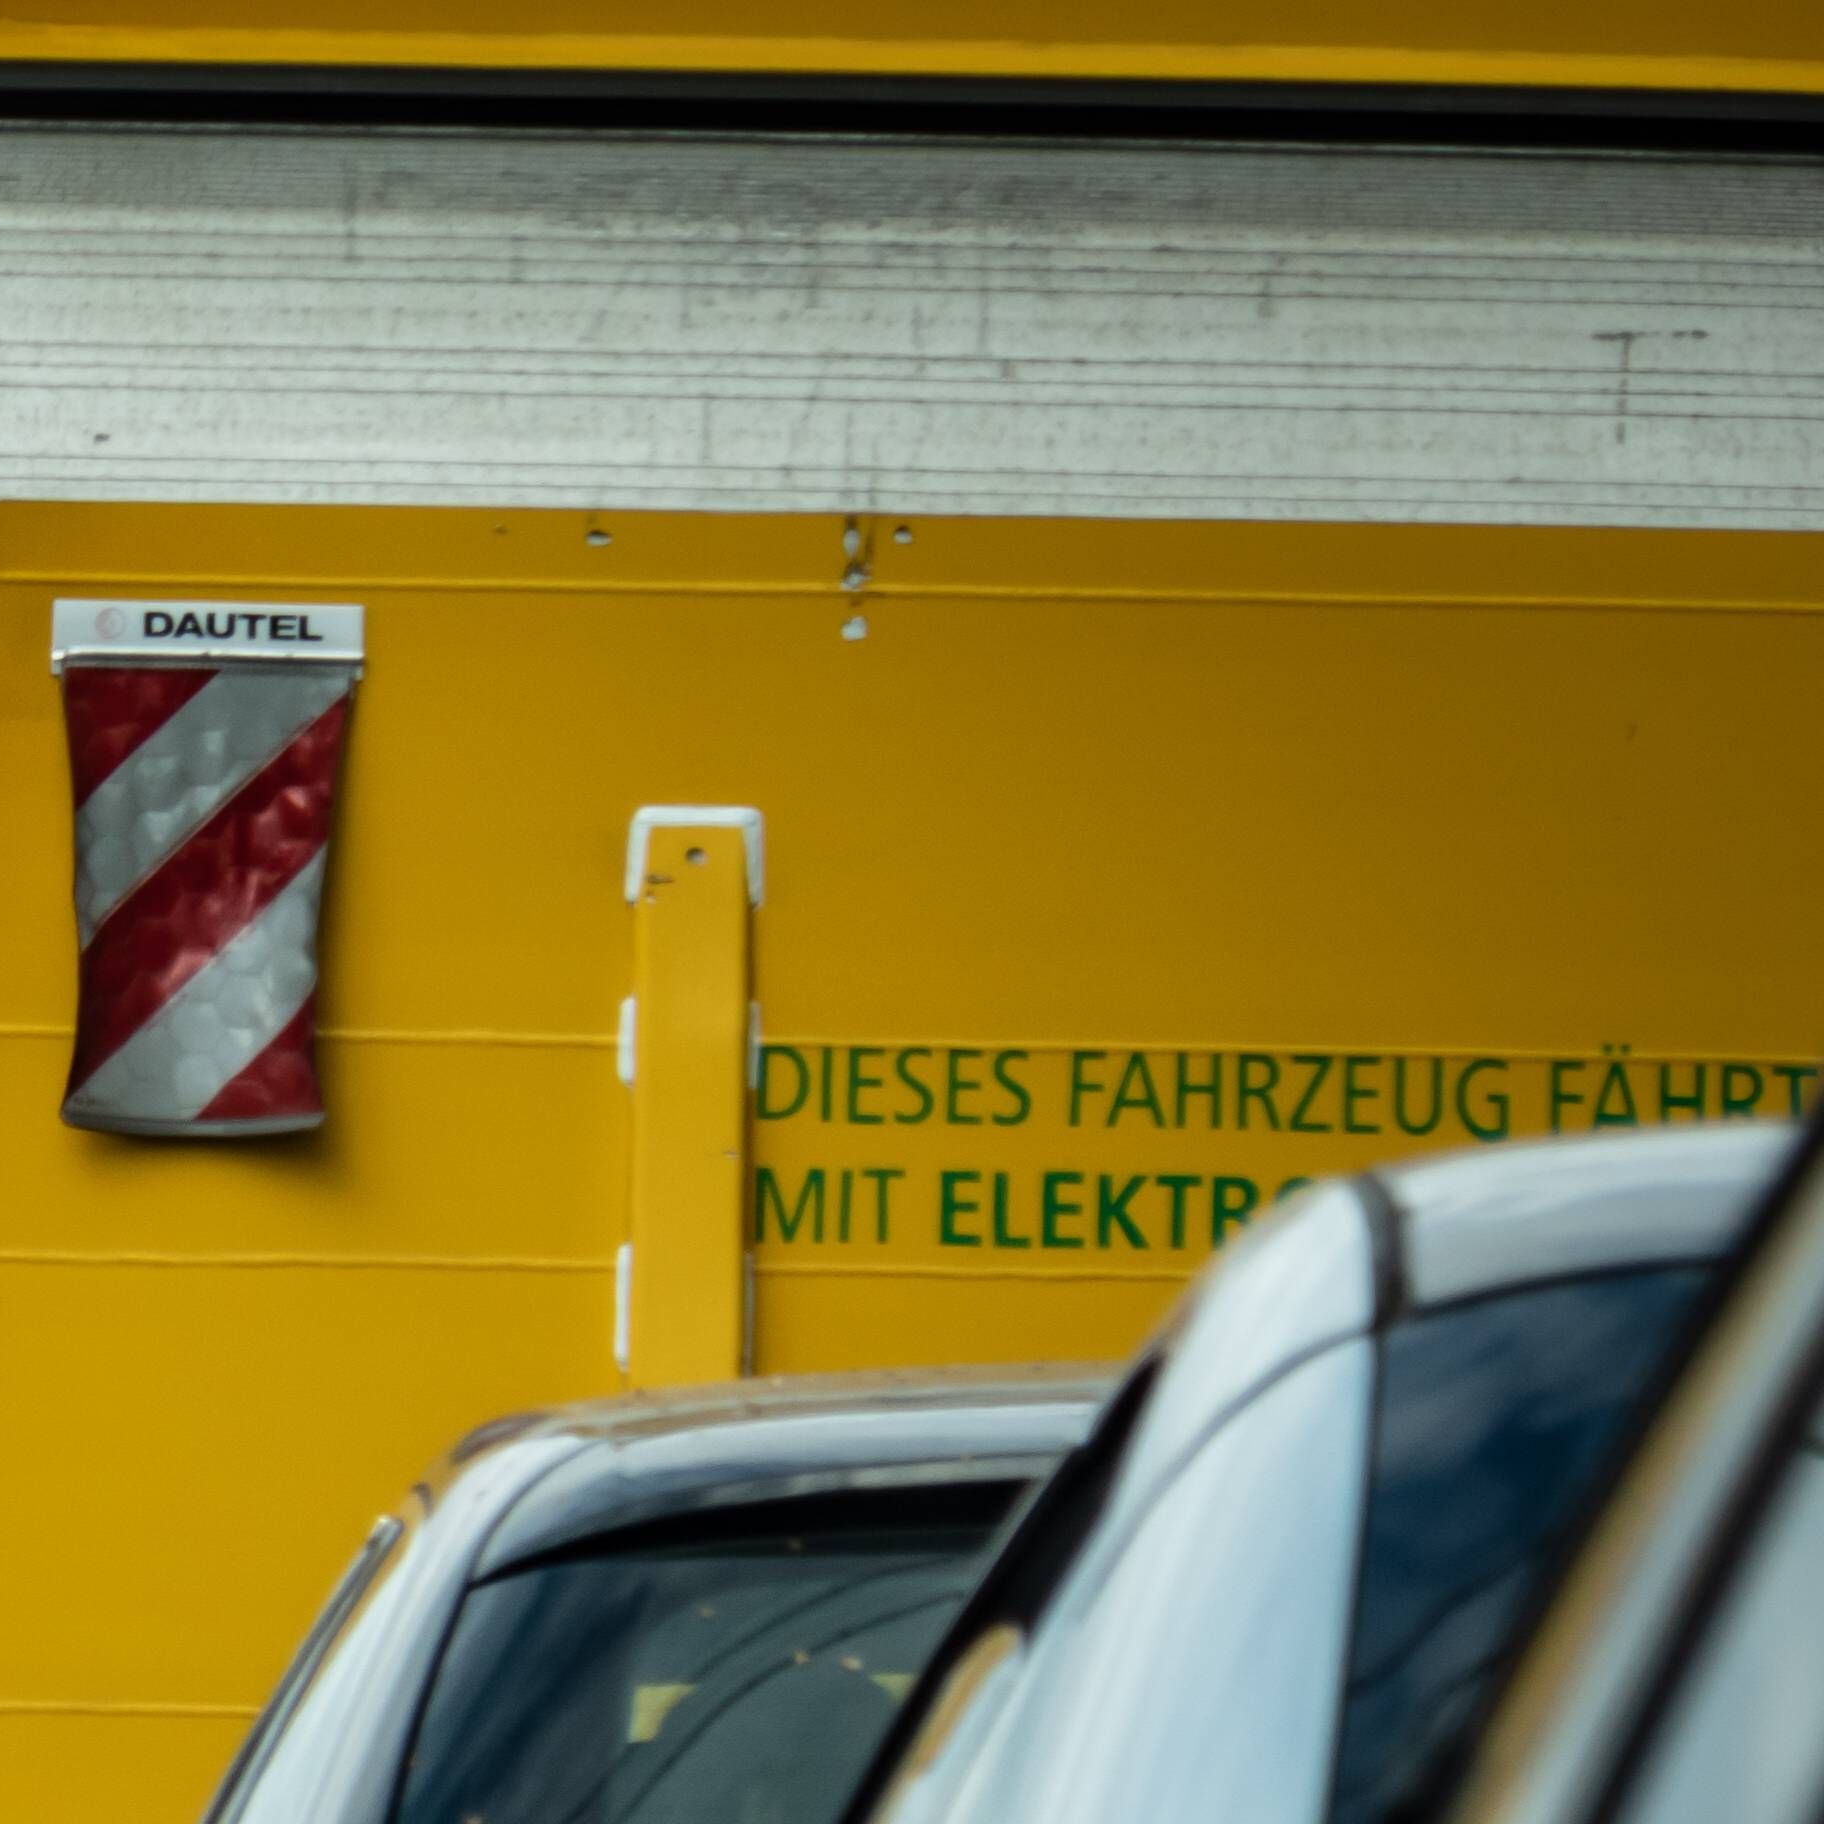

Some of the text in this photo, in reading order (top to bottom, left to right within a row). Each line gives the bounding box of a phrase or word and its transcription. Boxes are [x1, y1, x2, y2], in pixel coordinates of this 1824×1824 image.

[143, 612, 324, 640] DAUTEL
[757, 1042, 1819, 1143] DIESES FAHRZEUG FÄHRT
[756, 1166, 1314, 1250] MIT ELEKTR
